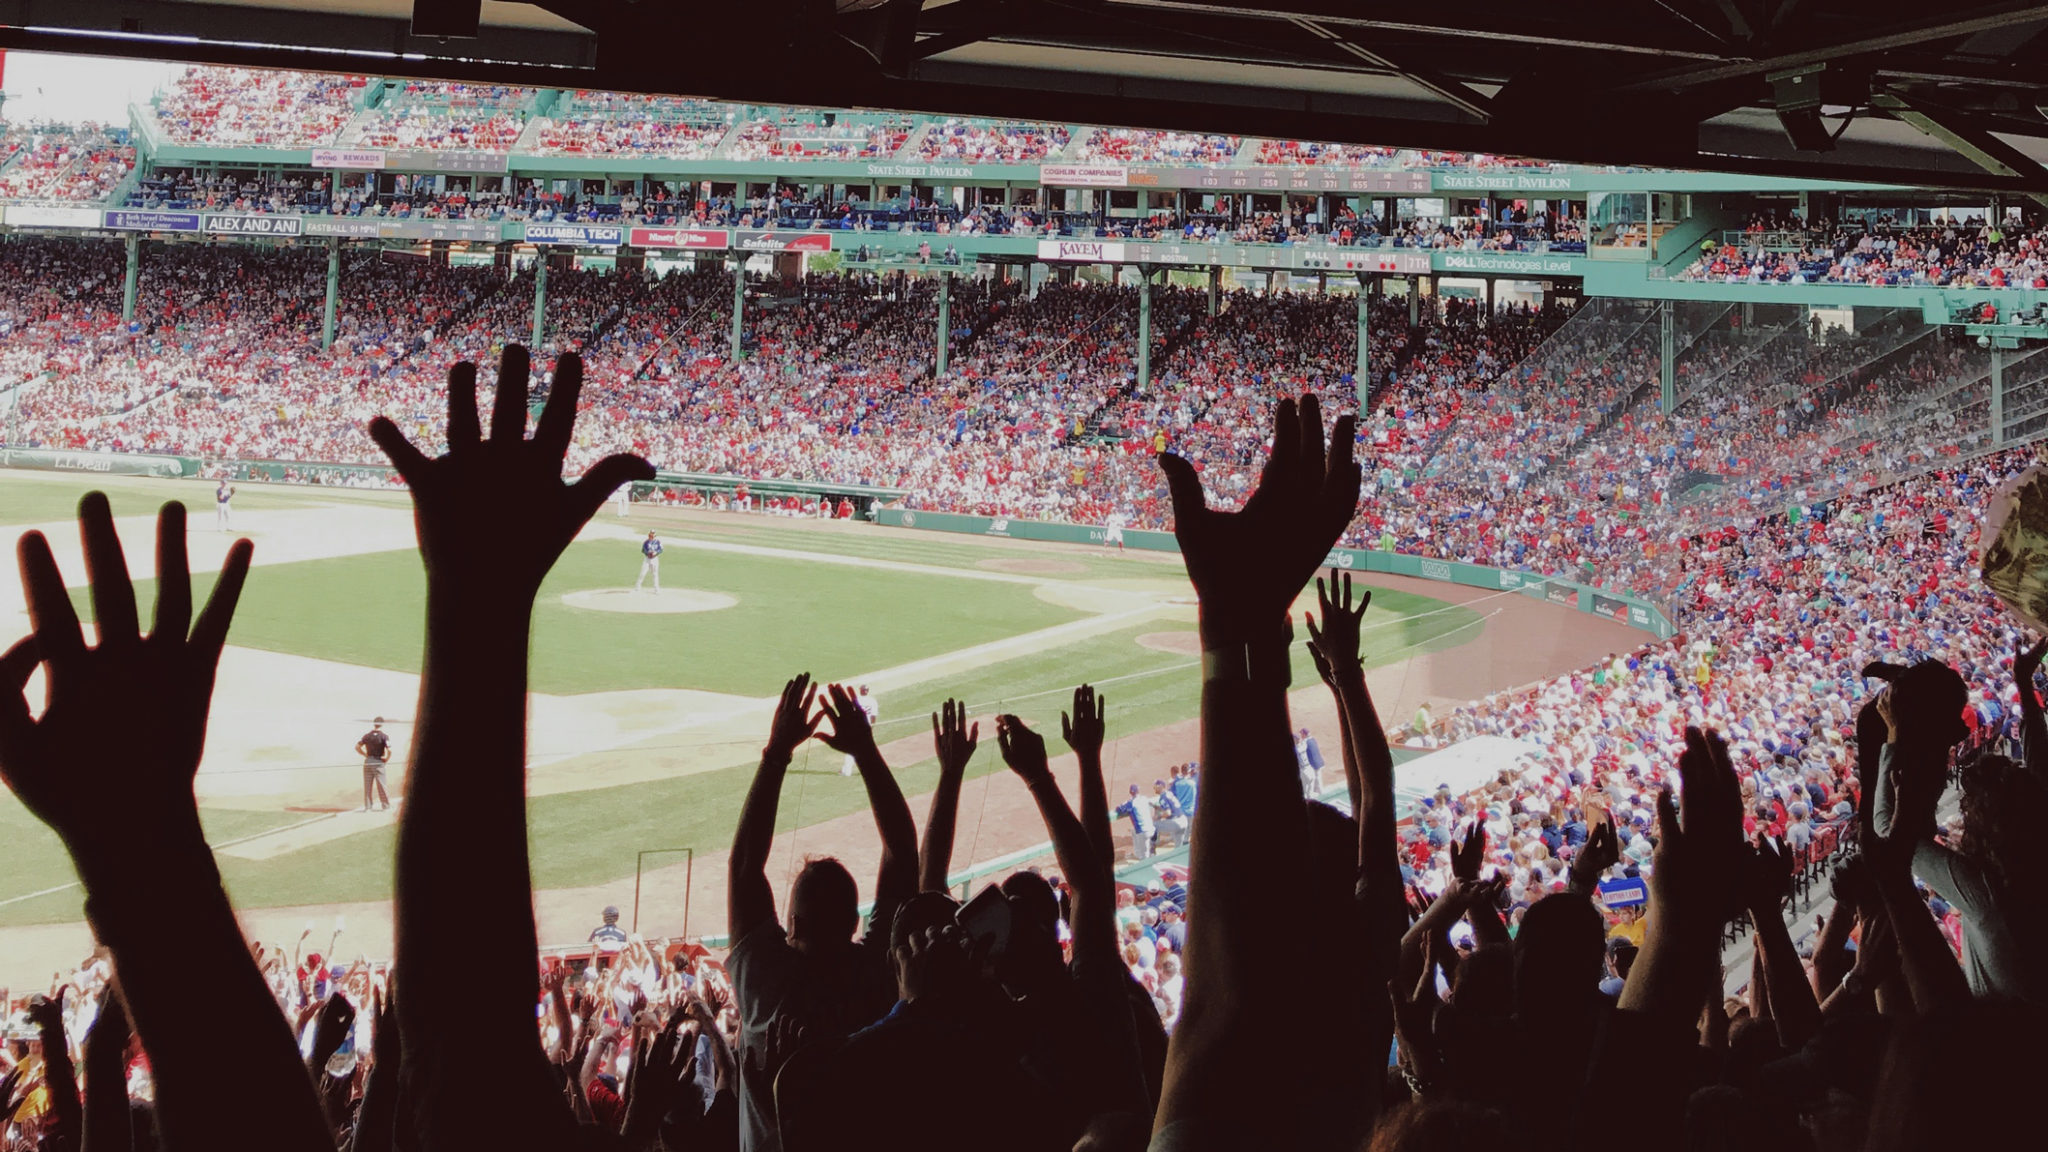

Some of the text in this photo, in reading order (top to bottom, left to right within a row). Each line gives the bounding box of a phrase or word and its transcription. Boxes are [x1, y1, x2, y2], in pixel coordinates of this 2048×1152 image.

[343, 154, 380, 162] REWARDS
[867, 164, 973, 177] STATE STREET PAVILION
[1078, 169, 1123, 177] COMPANIES
[1443, 175, 1571, 189] STATE STREET PAVILION
[208, 217, 297, 233] ALEX AND ANI
[306, 223, 346, 233] FASTBALL
[360, 225, 377, 234] MPH
[434, 230, 443, 238] 19
[527, 226, 618, 240] COLUMBIA TECH
[648, 232, 707, 243] Ninety Nine
[743, 238, 785, 249] Safelite
[1059, 242, 1103, 259] KAYEM
[1170, 246, 1180, 254] TB
[1160, 254, 1189, 263] BOSTON
[1270, 258, 1276, 266] 0
[1304, 251, 1397, 262] BALL STRIKE OUT
[1409, 256, 1430, 269] 7TH
[1445, 255, 1571, 272] DELL Technologies Level
